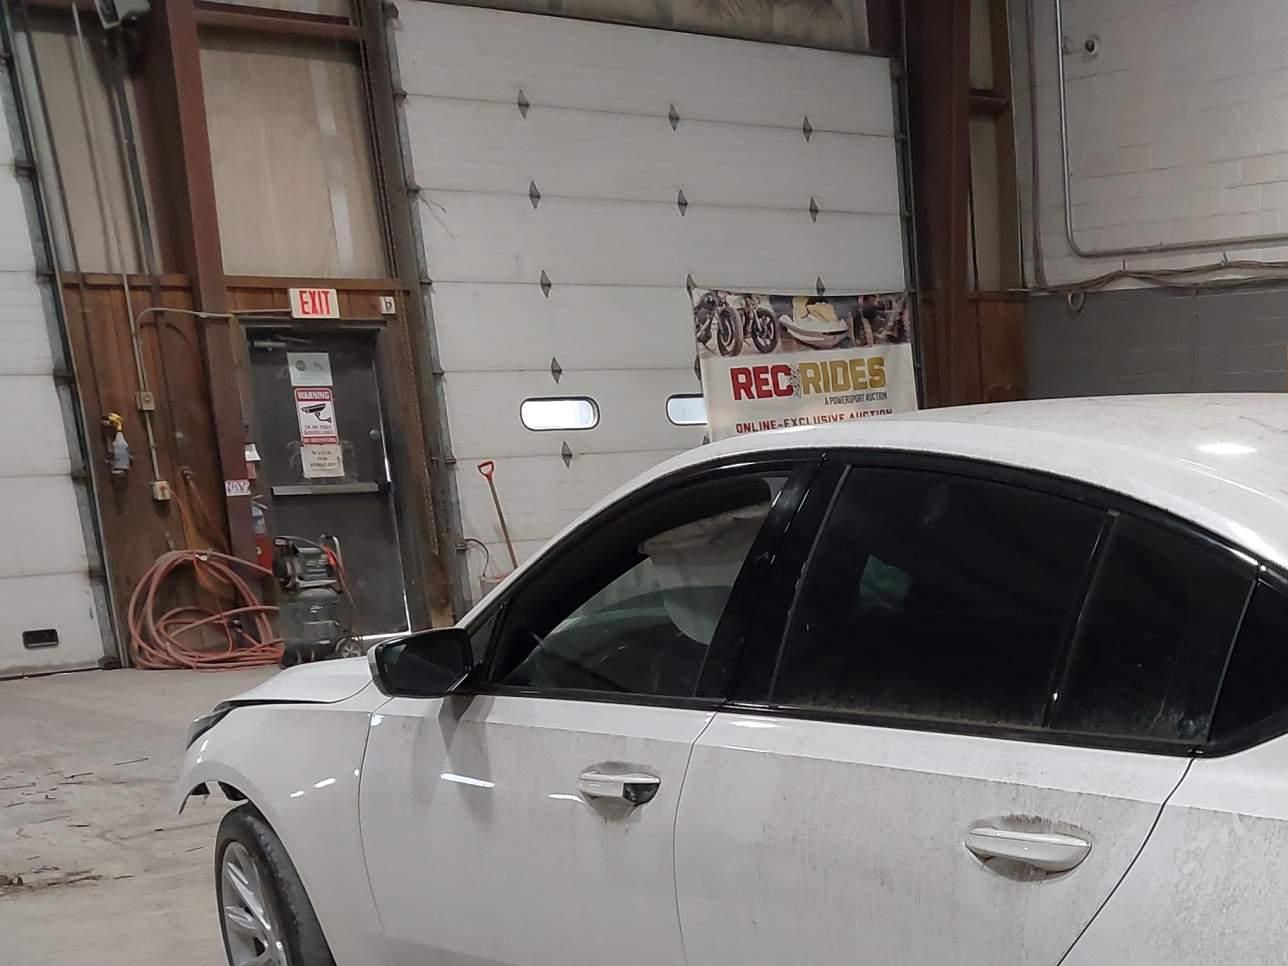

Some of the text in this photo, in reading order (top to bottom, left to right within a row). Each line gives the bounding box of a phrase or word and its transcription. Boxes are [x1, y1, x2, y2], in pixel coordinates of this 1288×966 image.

[299, 290, 331, 315] EXIT
[730, 357, 887, 400] REC RIDES
[297, 391, 330, 400] WARNING
[865, 391, 888, 402] AUCTION
[736, 413, 844, 433] ONLINE-EXCLUSIVE
